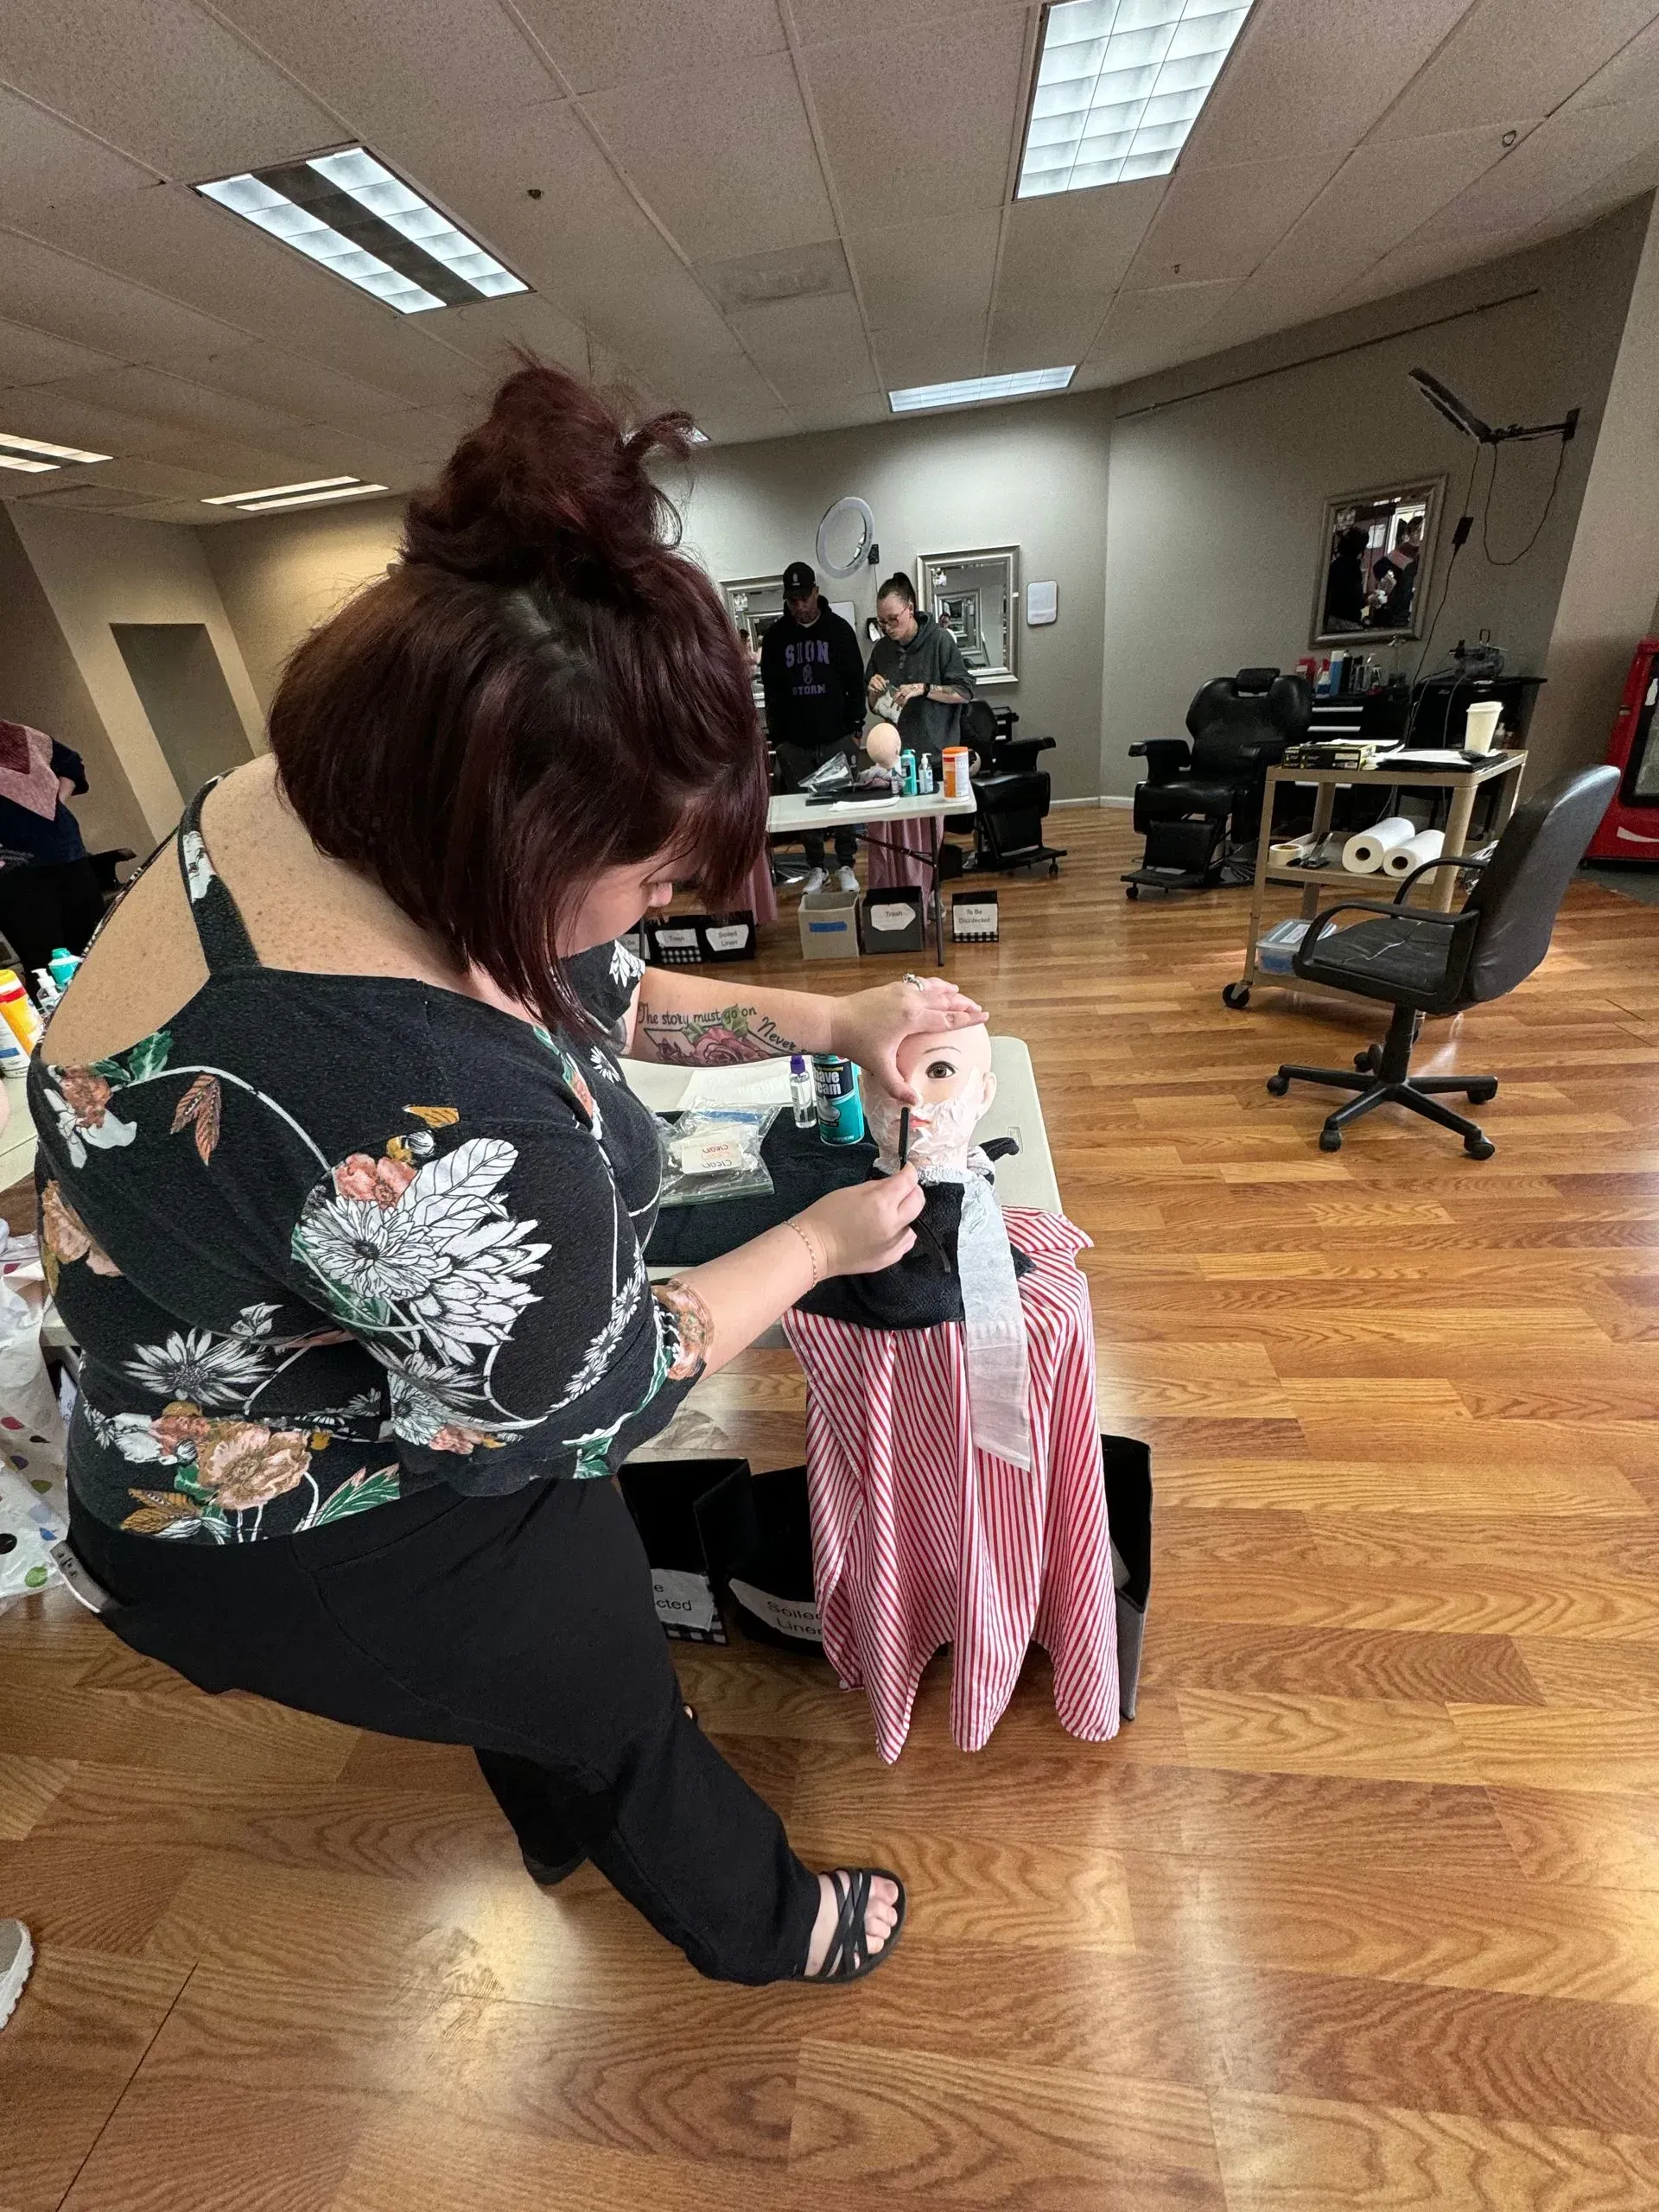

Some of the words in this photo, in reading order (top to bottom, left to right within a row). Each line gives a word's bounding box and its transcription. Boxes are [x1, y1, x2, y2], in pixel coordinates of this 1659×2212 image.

[792, 683, 826, 696] STORM
[638, 1002, 659, 1025] The
[662, 1012, 690, 1027] story
[693, 1009, 721, 1023] must
[722, 1007, 738, 1021] go
[742, 1006, 758, 1018] on
[757, 1016, 796, 1051] Never
[813, 1068, 840, 1084] have
[814, 1081, 842, 1096] ream
